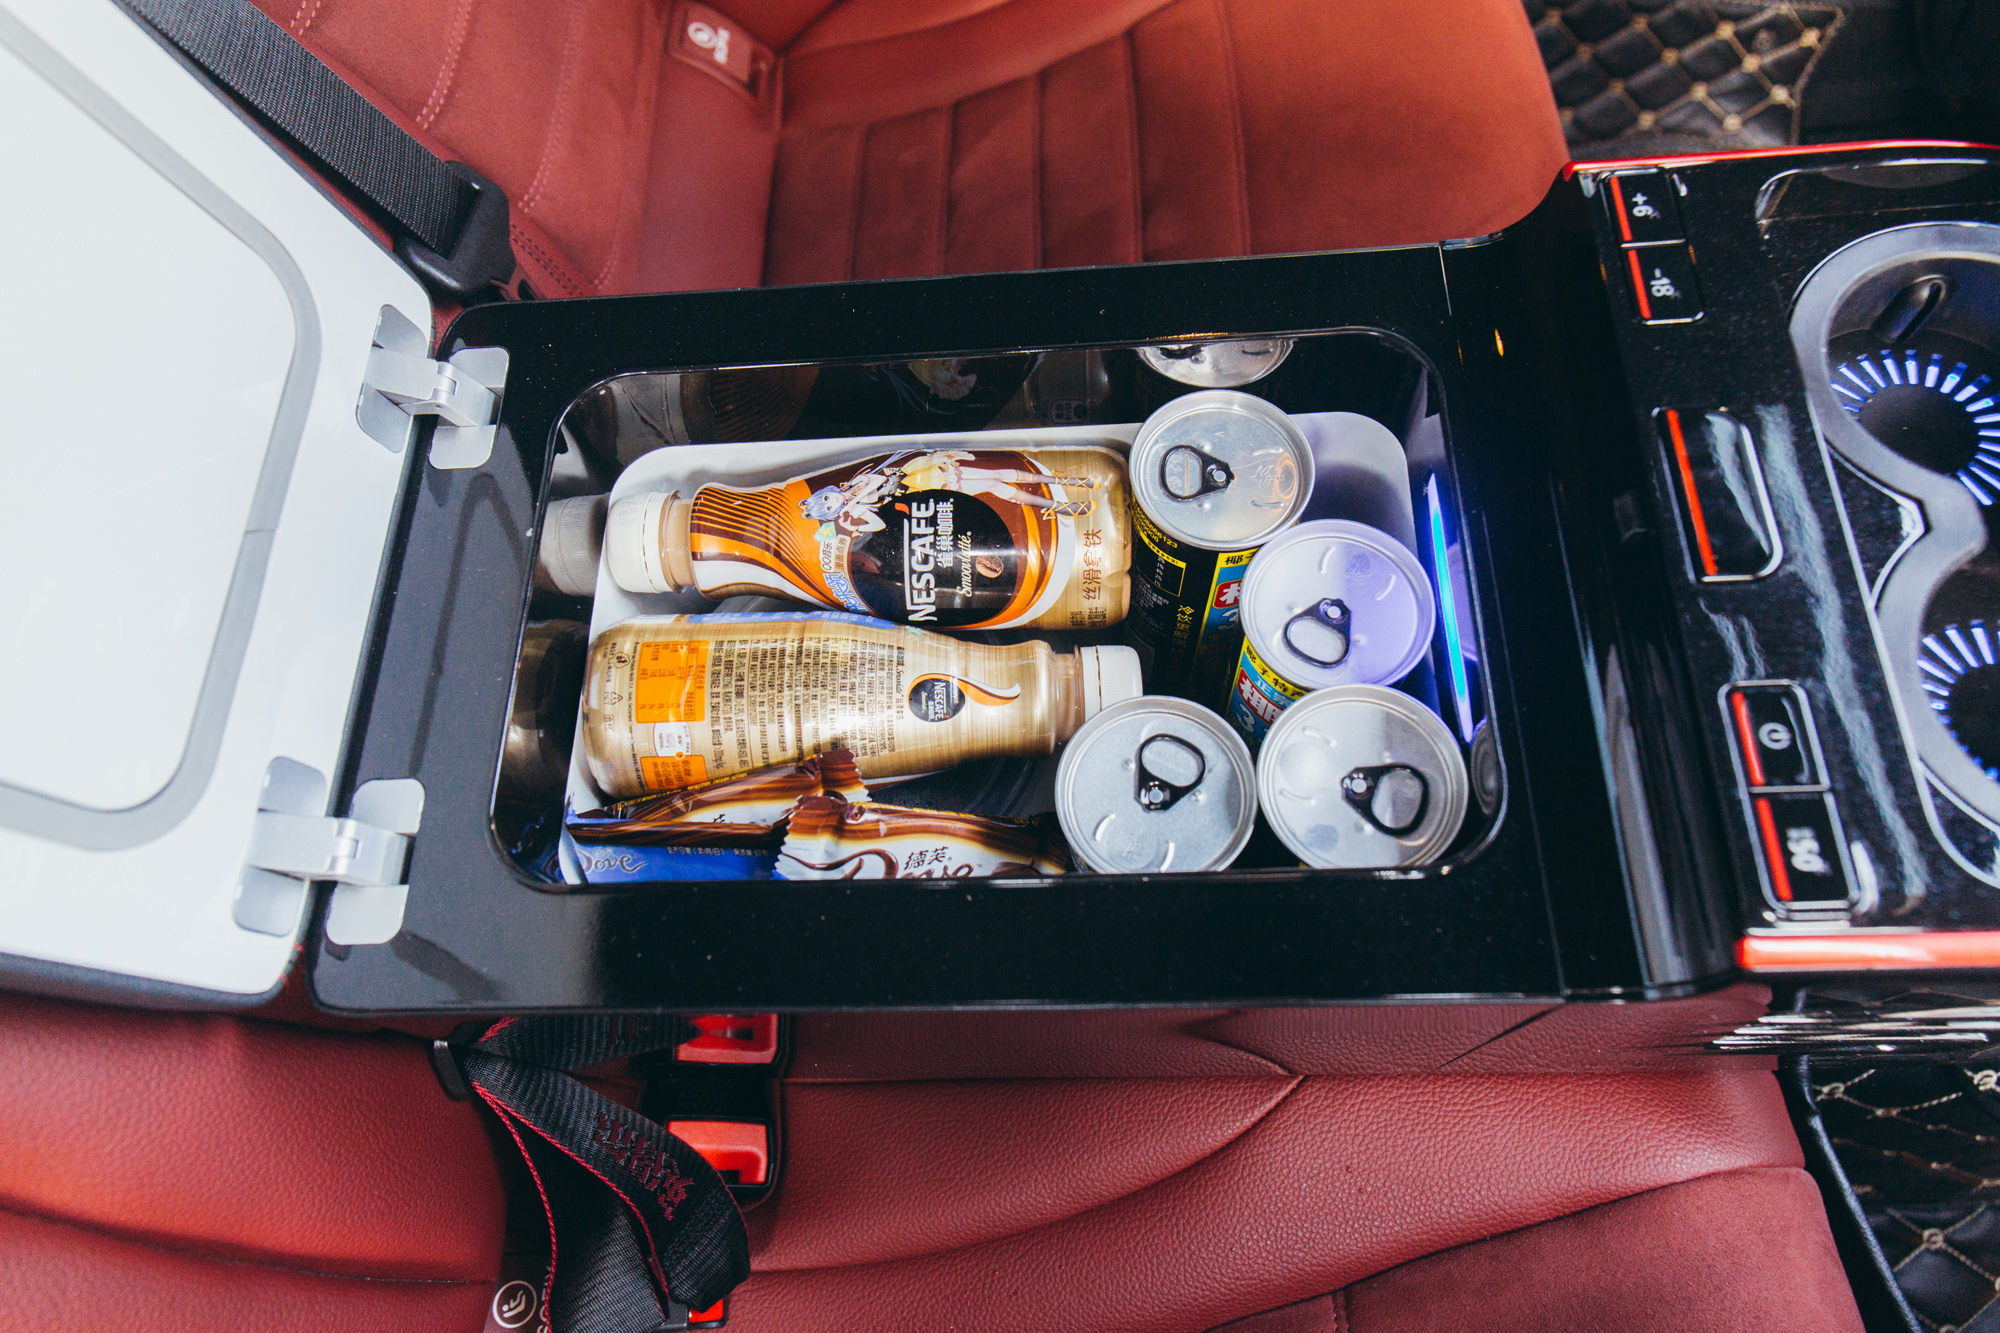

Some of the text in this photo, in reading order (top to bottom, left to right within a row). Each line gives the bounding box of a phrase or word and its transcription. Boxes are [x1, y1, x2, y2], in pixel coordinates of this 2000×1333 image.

[936, 501, 954, 569] 雀巢咖啡
[1082, 528, 1102, 601] 丝滑拿铁
[903, 846, 949, 871] 德芙
